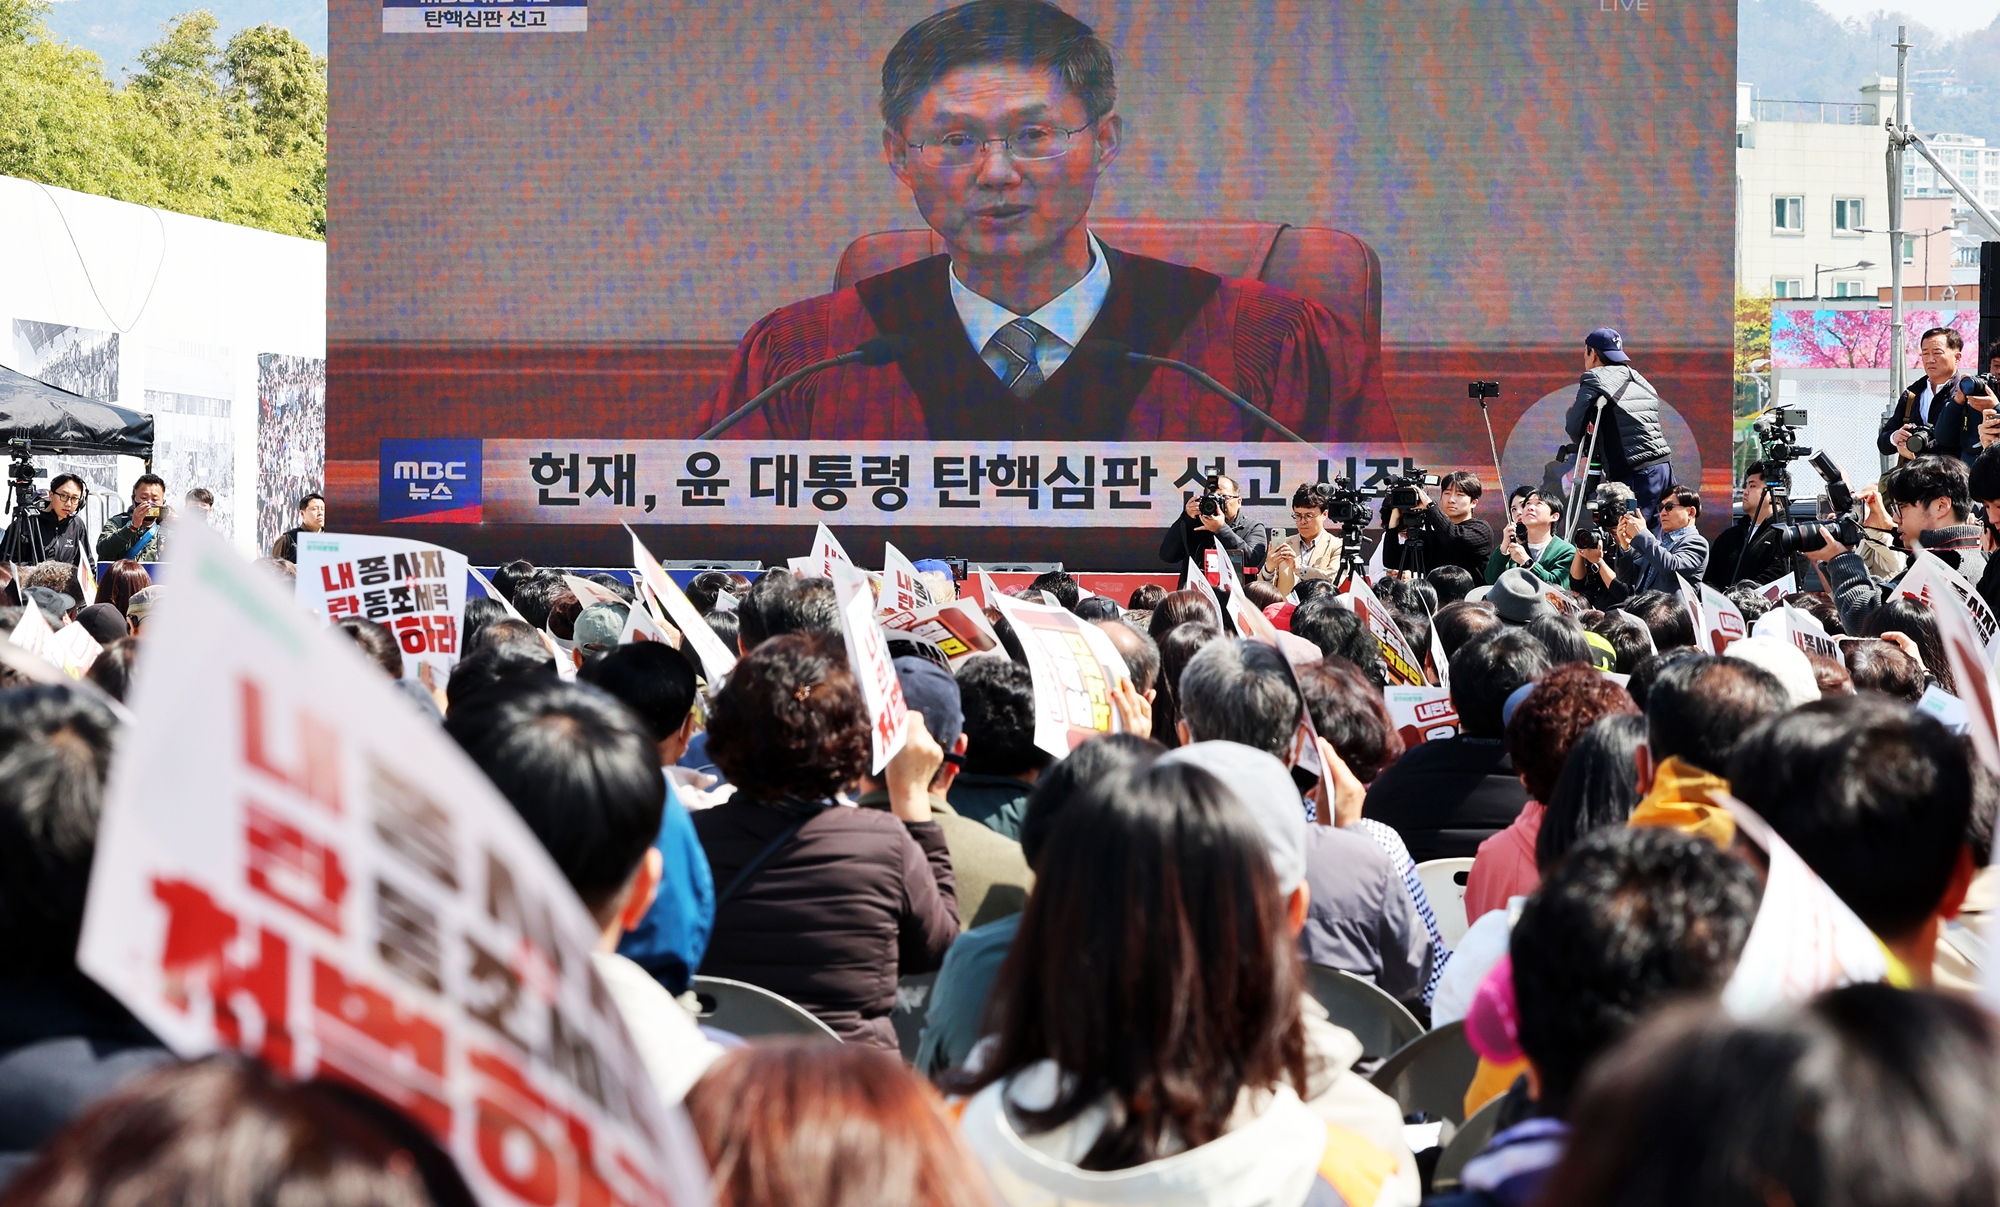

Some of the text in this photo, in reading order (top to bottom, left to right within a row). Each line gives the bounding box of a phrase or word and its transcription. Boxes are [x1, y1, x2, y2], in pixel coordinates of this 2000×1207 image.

[1600, 0, 1649, 11] LIVE
[424, 10, 547, 28] 탄핵심판 선고
[393, 461, 466, 479] MBC
[408, 482, 453, 500] 뉴스
[528, 451, 657, 513] 헌재,
[676, 451, 730, 508] 윤
[750, 453, 909, 512] 대통령
[933, 454, 1158, 510] 탄핵심판
[363, 583, 450, 619] 동조세력
[378, 615, 458, 655] 하라
